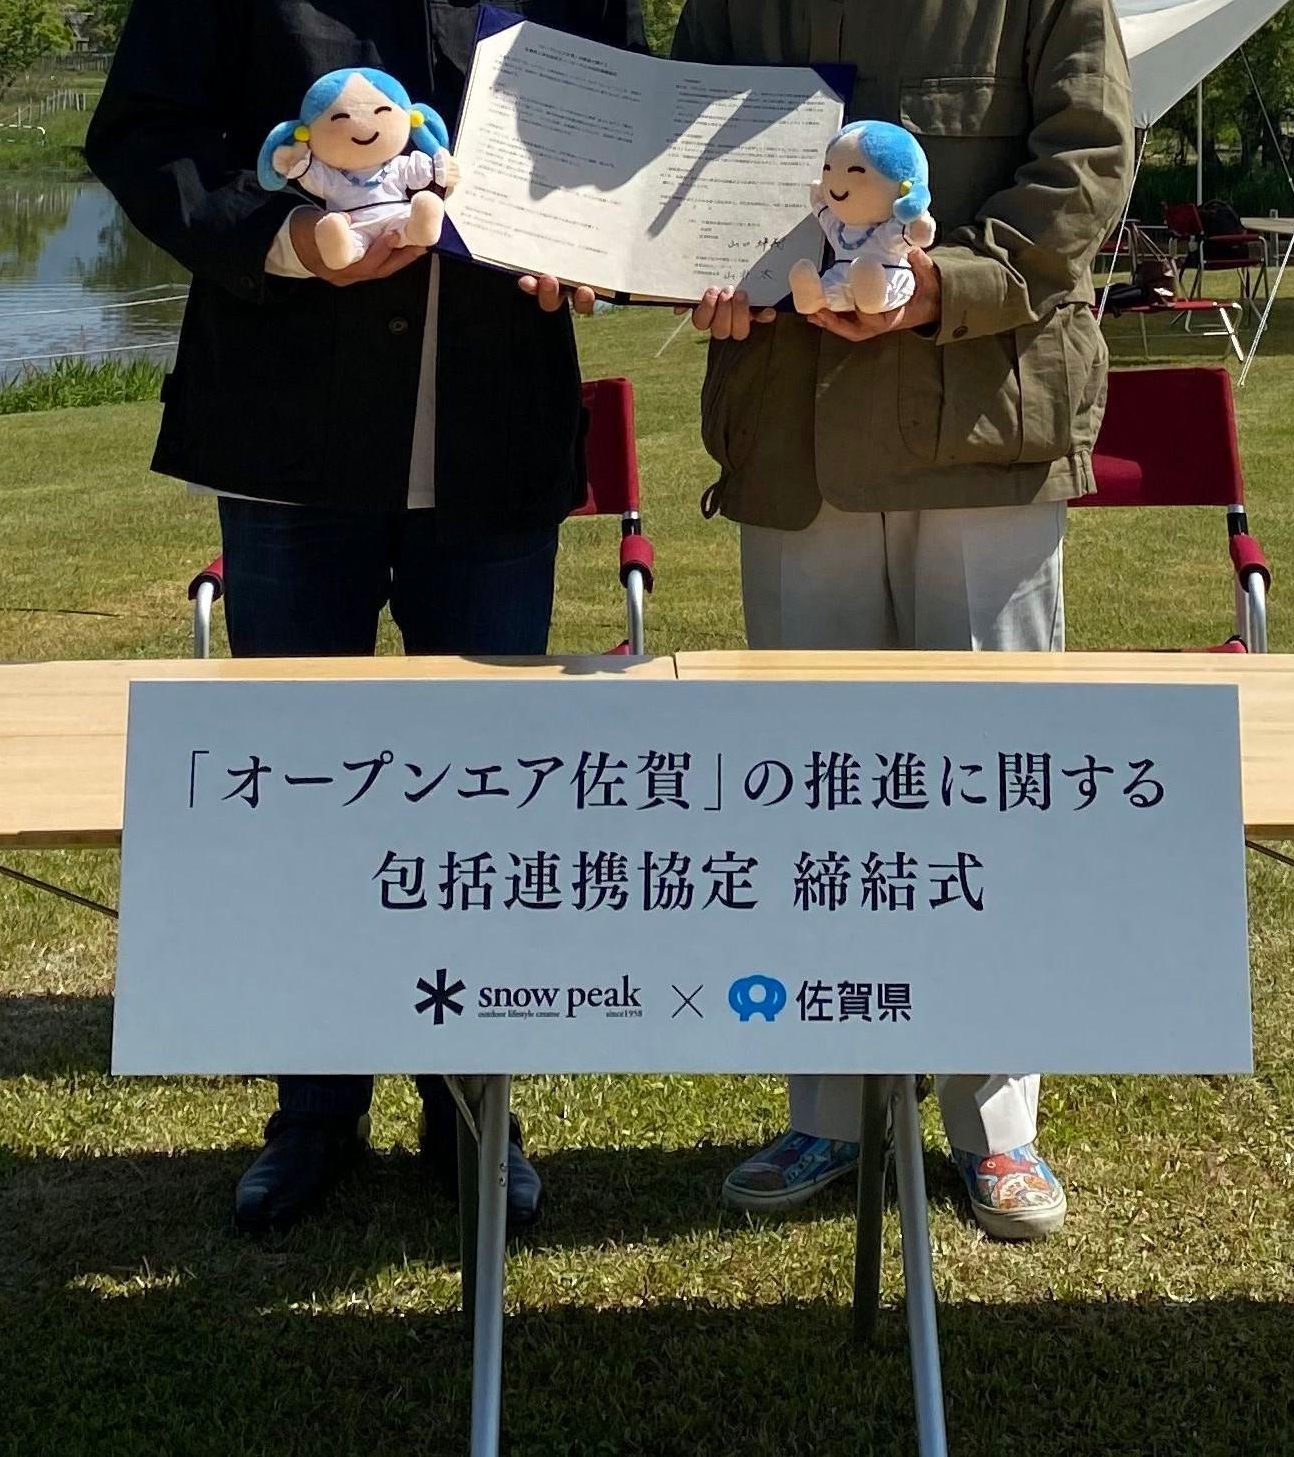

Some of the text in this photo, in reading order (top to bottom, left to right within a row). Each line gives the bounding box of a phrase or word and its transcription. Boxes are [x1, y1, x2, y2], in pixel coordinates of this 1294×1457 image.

[189, 749, 1165, 812] 「オープンエア佐賀」の推進に関する
[372, 850, 984, 912] 包括連携協定 締結式
[478, 974, 642, 1018] snow peak
[795, 979, 912, 1023] 佐賀県
